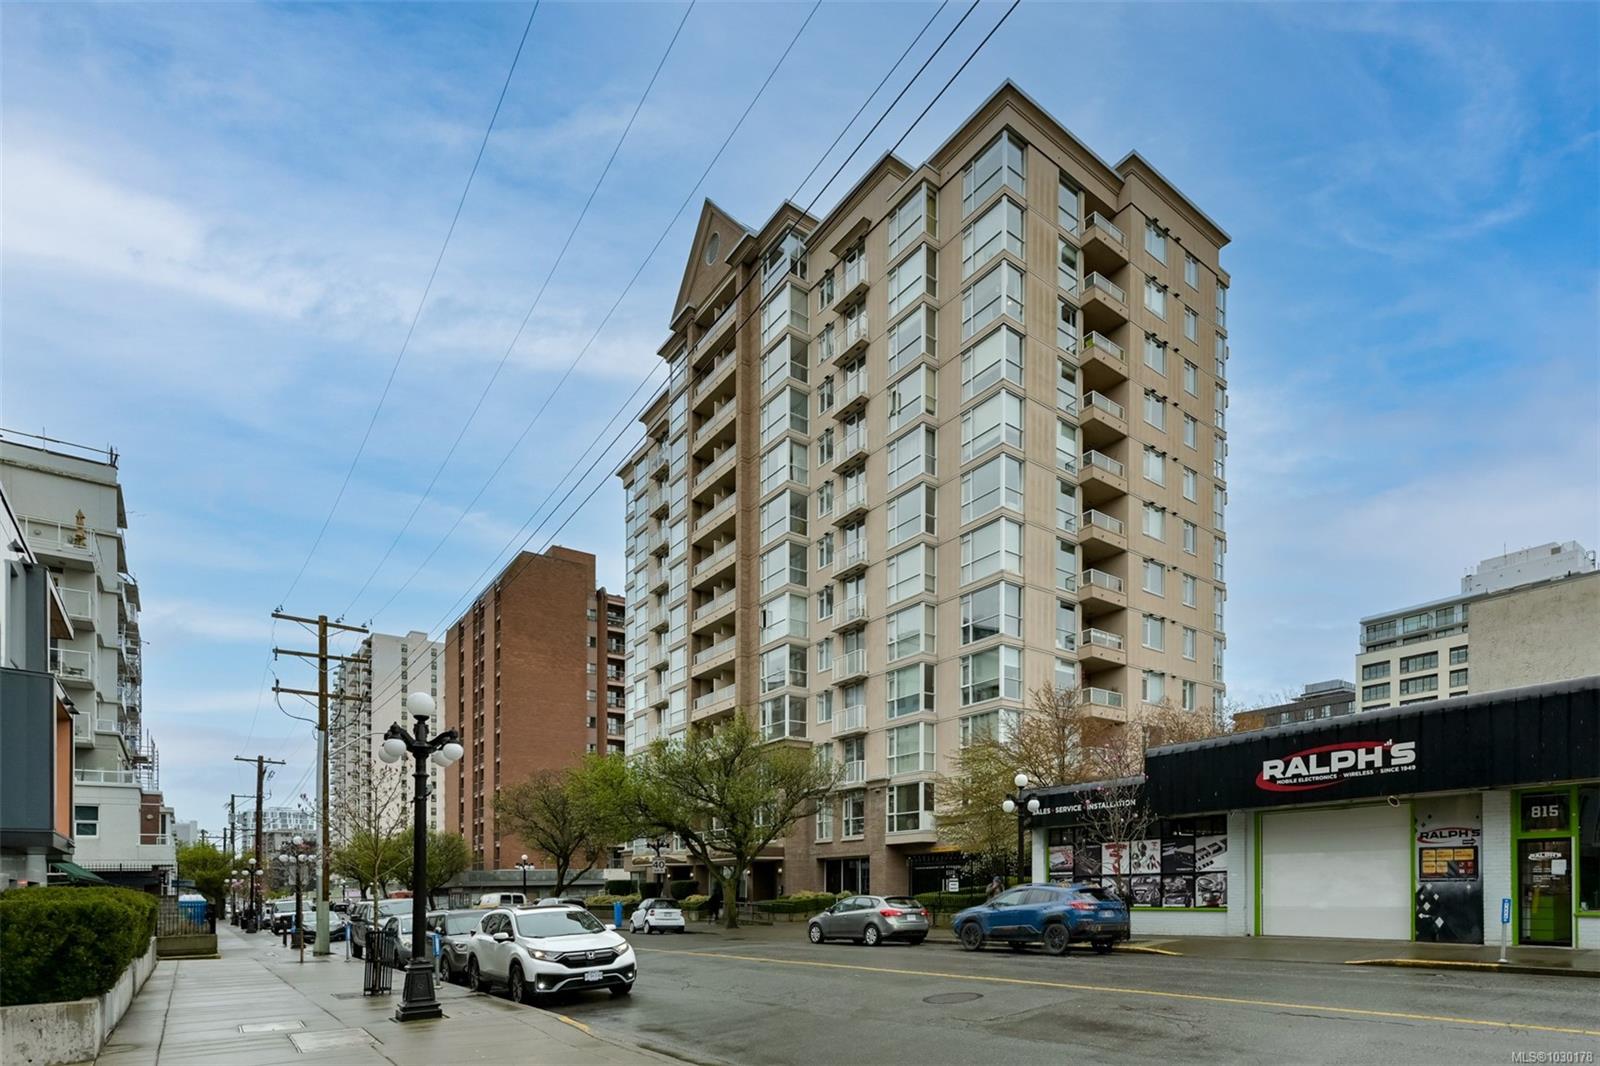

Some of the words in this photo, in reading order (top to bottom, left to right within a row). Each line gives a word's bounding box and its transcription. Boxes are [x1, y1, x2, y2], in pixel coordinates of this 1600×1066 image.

[1262, 739, 1417, 781] RALPH'S
[1276, 777, 1298, 785] MOBILE
[1298, 773, 1337, 783] ELECTRONICS
[1343, 769, 1374, 778] WIRELESS
[1380, 766, 1400, 774] SINCE
[1401, 764, 1417, 772] 1949
[1032, 807, 1051, 816] SALES
[1055, 804, 1082, 814] SERVICE
[1087, 799, 1136, 811] INSTALLATION
[1531, 804, 1559, 818] 815
[653, 860, 665, 869] 40
